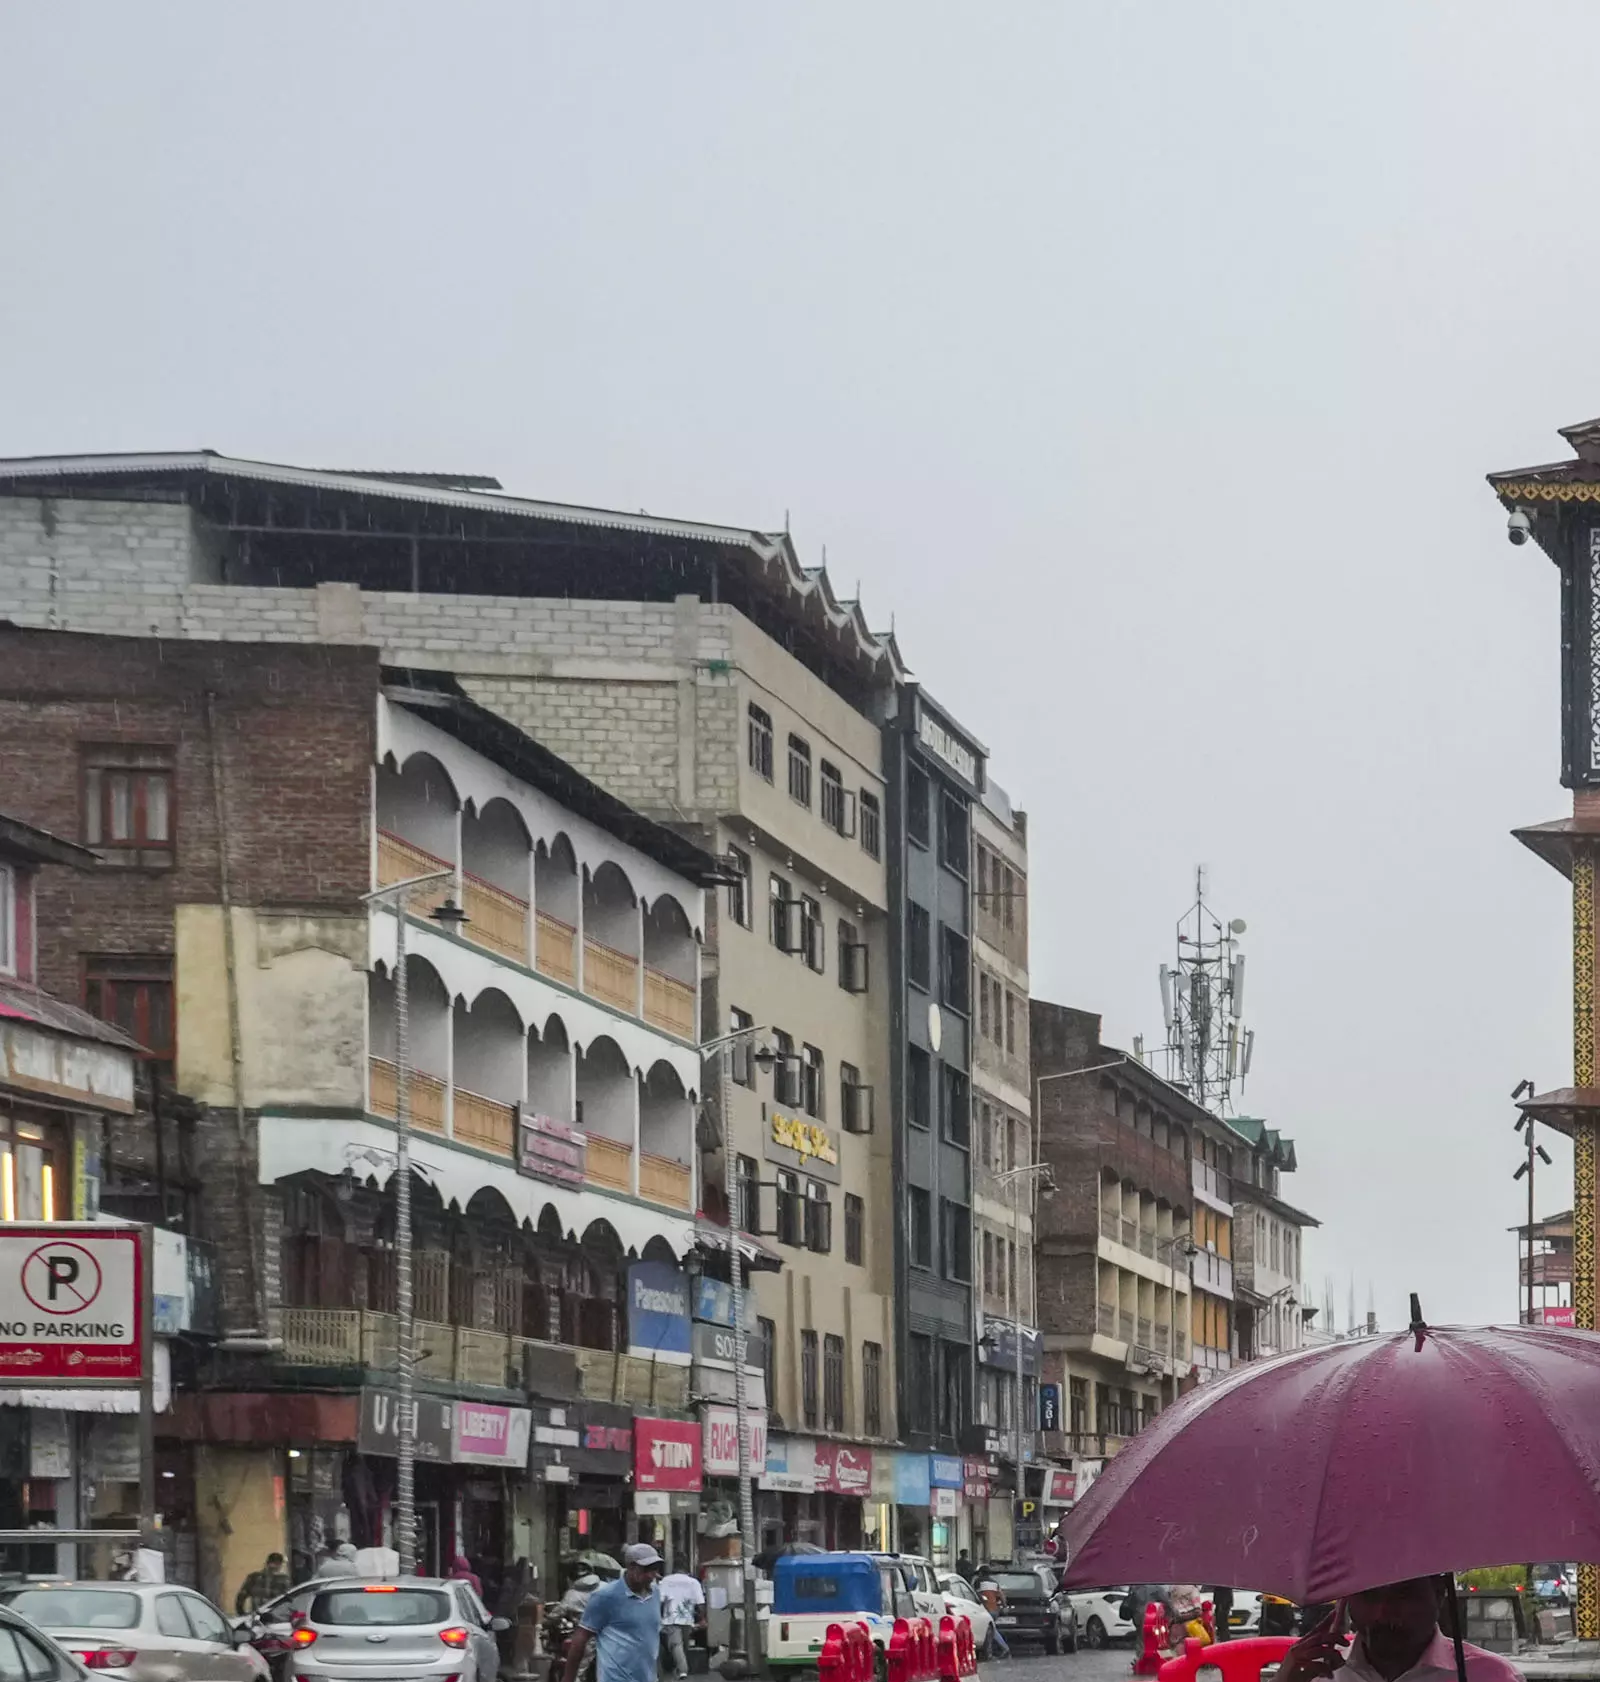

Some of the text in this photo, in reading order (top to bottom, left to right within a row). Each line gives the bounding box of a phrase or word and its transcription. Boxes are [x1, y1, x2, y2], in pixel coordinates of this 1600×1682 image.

[635, 1278, 684, 1316] Panasonic
[0, 1322, 125, 1338] NO PARKING
[461, 1410, 507, 1441] LIBERTY
[711, 1424, 766, 1464] RIGHAY
[1022, 1501, 1036, 1518] P
